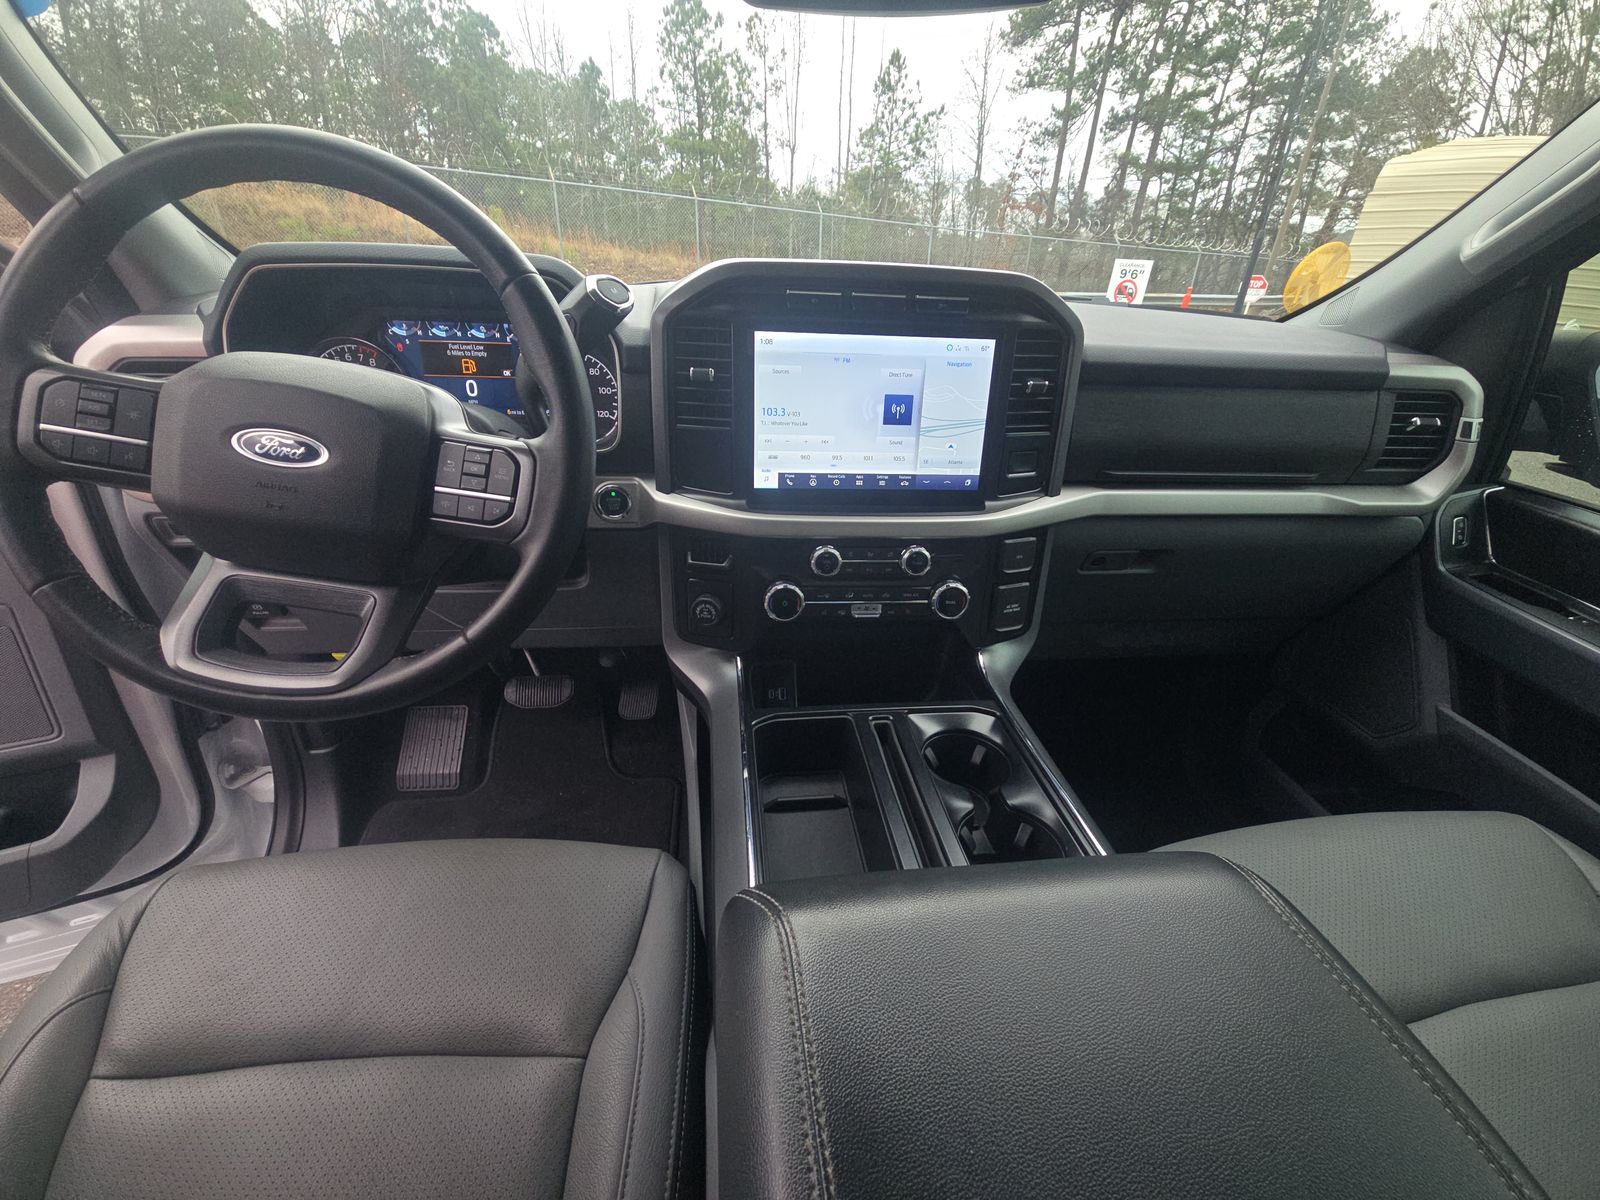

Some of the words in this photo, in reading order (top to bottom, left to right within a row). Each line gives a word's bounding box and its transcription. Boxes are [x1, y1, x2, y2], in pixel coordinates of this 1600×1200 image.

[1119, 269, 1145, 279] 9'6"
[345, 353, 352, 361] 6
[357, 353, 364, 361] 7
[369, 358, 376, 366] 8
[465, 380, 478, 397] 0
[596, 410, 610, 418] 120
[761, 407, 786, 417] 103.3
[255, 435, 306, 460] Ford
